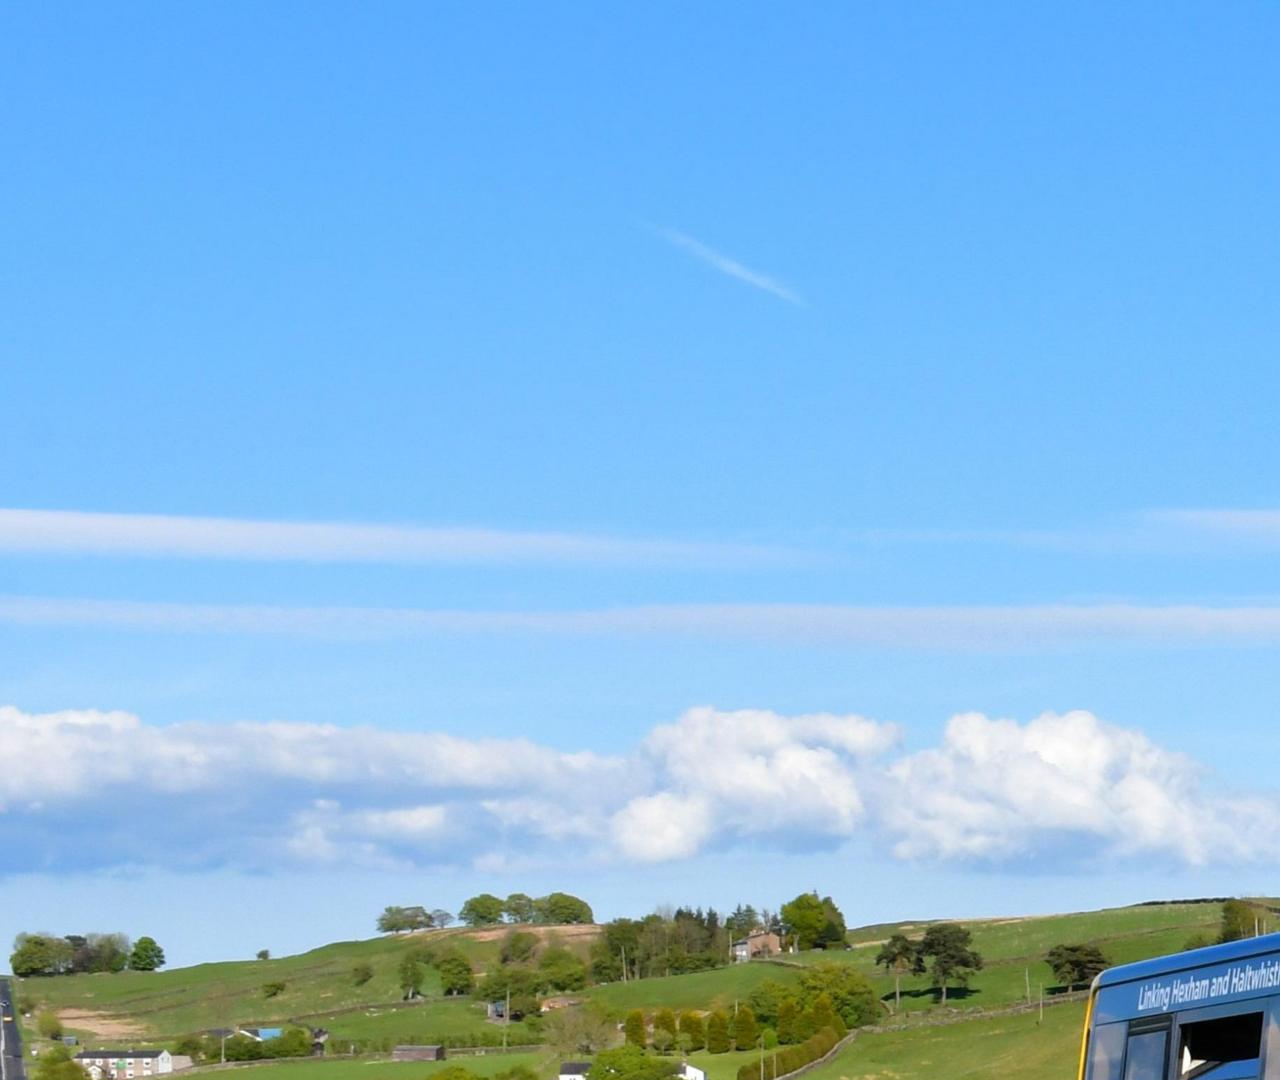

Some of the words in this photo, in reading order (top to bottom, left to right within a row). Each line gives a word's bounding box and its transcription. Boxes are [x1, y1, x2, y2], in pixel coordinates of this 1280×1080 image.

[1138, 984, 1171, 1011] Linking
[1171, 975, 1209, 1004] Hexham
[1209, 968, 1230, 995] and
